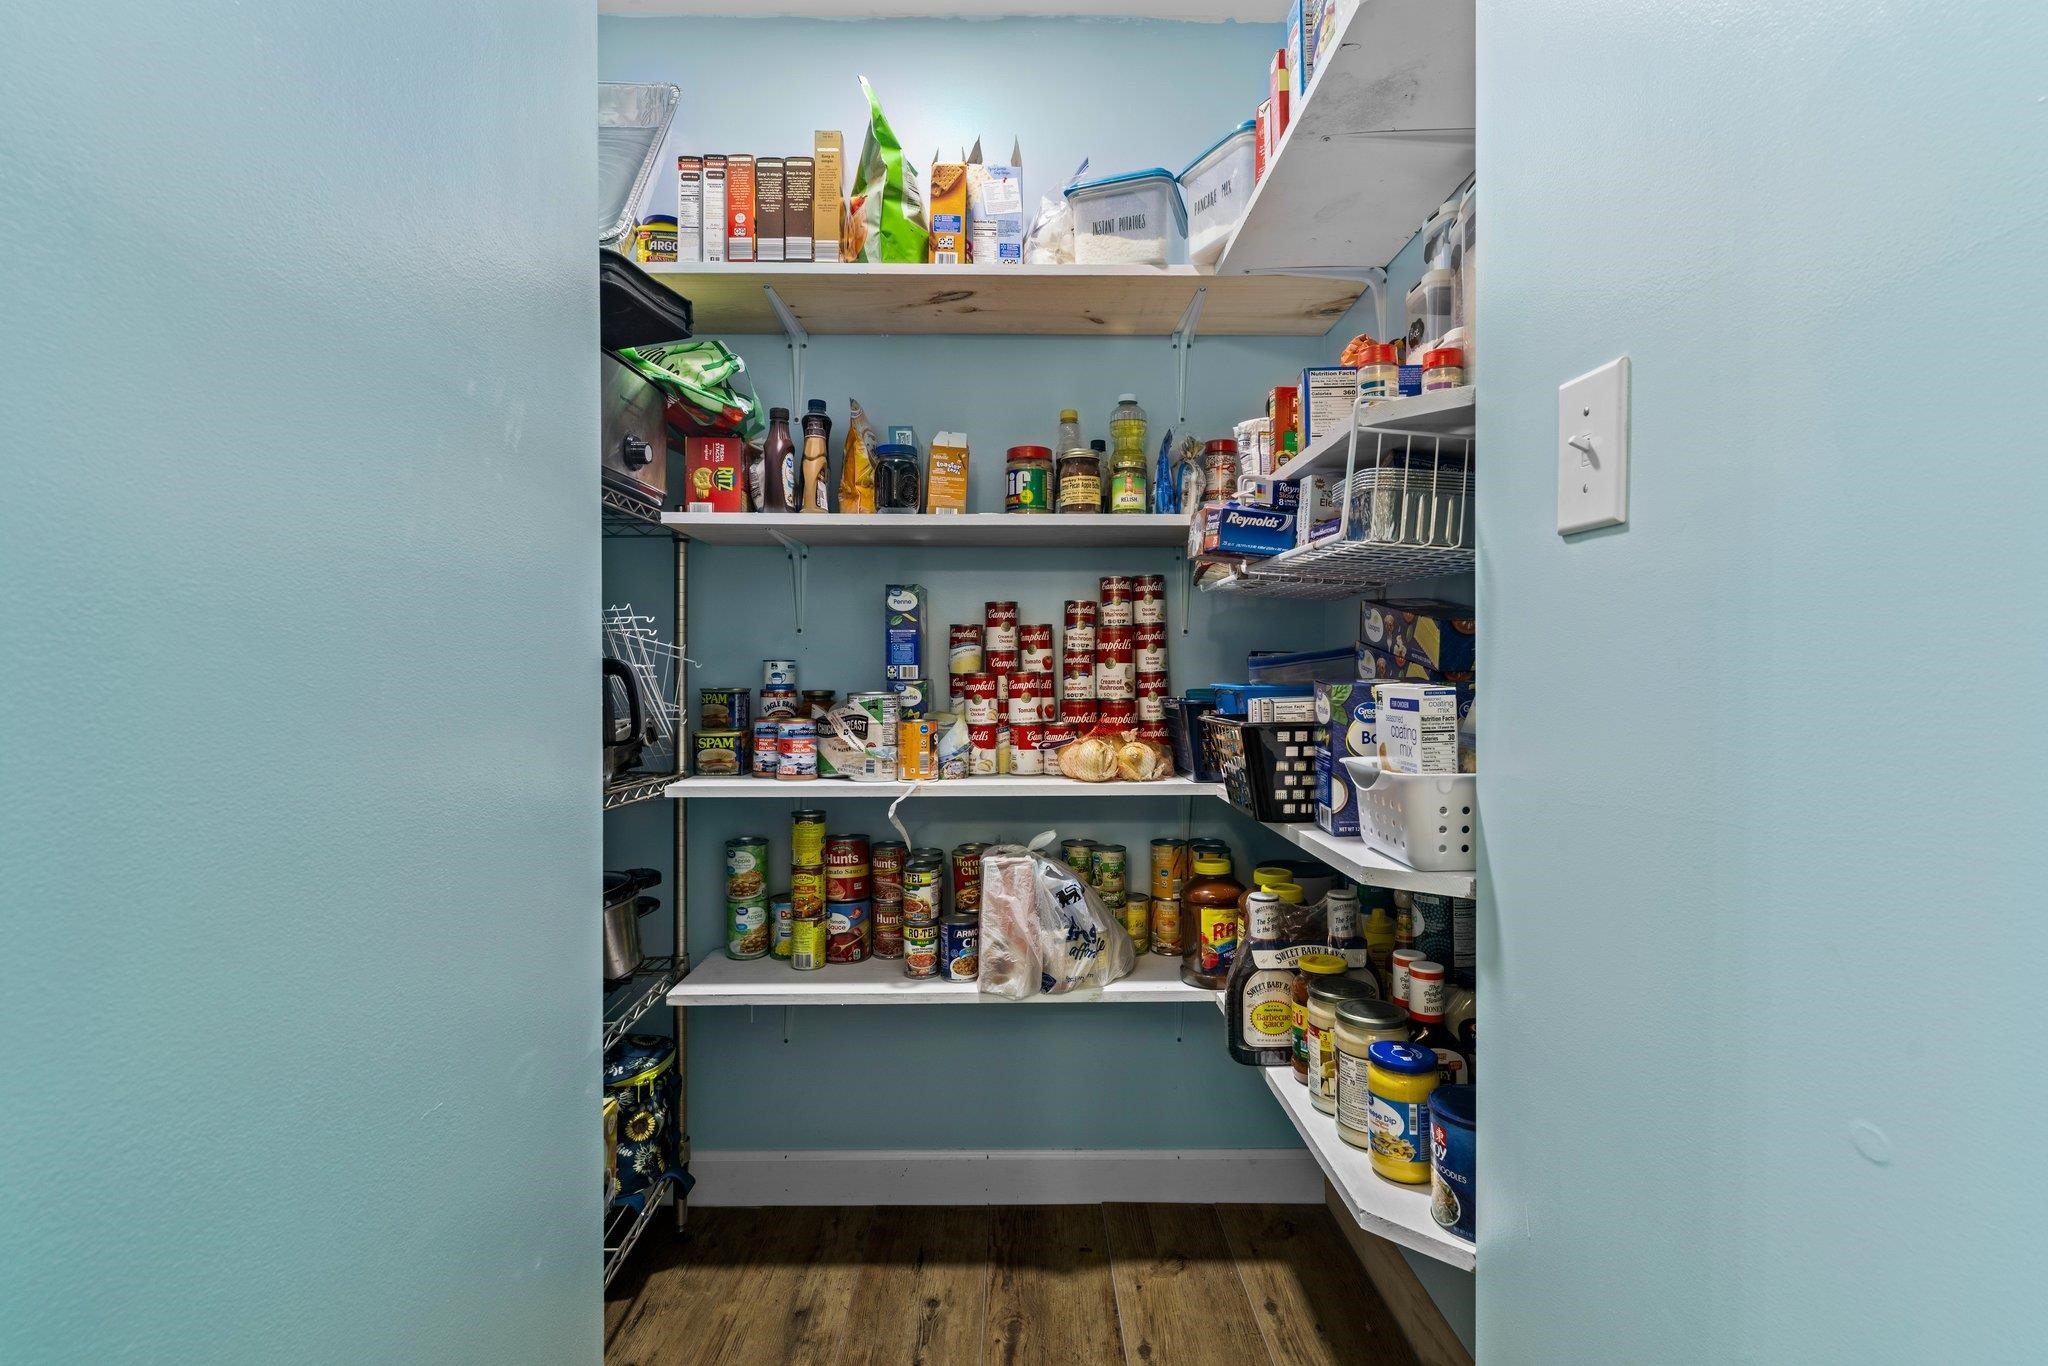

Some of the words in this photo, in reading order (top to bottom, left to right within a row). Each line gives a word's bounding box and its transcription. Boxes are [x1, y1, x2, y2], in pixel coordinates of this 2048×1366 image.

[1194, 189, 1217, 216] PANCAKE
[1092, 219, 1114, 236] INSTANT
[1118, 213, 1146, 231] POTATOES
[718, 467, 734, 491] RITZ
[1006, 471, 1032, 496] if
[1279, 482, 1300, 494] Reyn
[1278, 498, 1284, 506] 8
[1226, 512, 1280, 528] Reynolds
[701, 694, 727, 704] SPAM
[1429, 700, 1454, 708] coating
[764, 700, 781, 712] EAGLE
[1358, 707, 1376, 715] Grea
[1386, 714, 1404, 724] seasoned
[1391, 725, 1417, 746] coating
[698, 738, 734, 748] SPAM
[1400, 741, 1413, 758] mix
[961, 867, 979, 876] Chi
[956, 930, 978, 938] ARMO
[1213, 922, 1237, 941] RA
[1275, 947, 1300, 964] SWEET
[1301, 946, 1323, 956] BABY
[1246, 981, 1266, 998] SWEET
[1267, 981, 1283, 989] BABY
[1424, 1005, 1443, 1013] HONEY
[1256, 1013, 1291, 1021] Barbecue
[1263, 1020, 1284, 1029] Sauce
[1384, 1115, 1397, 1125] Dip
